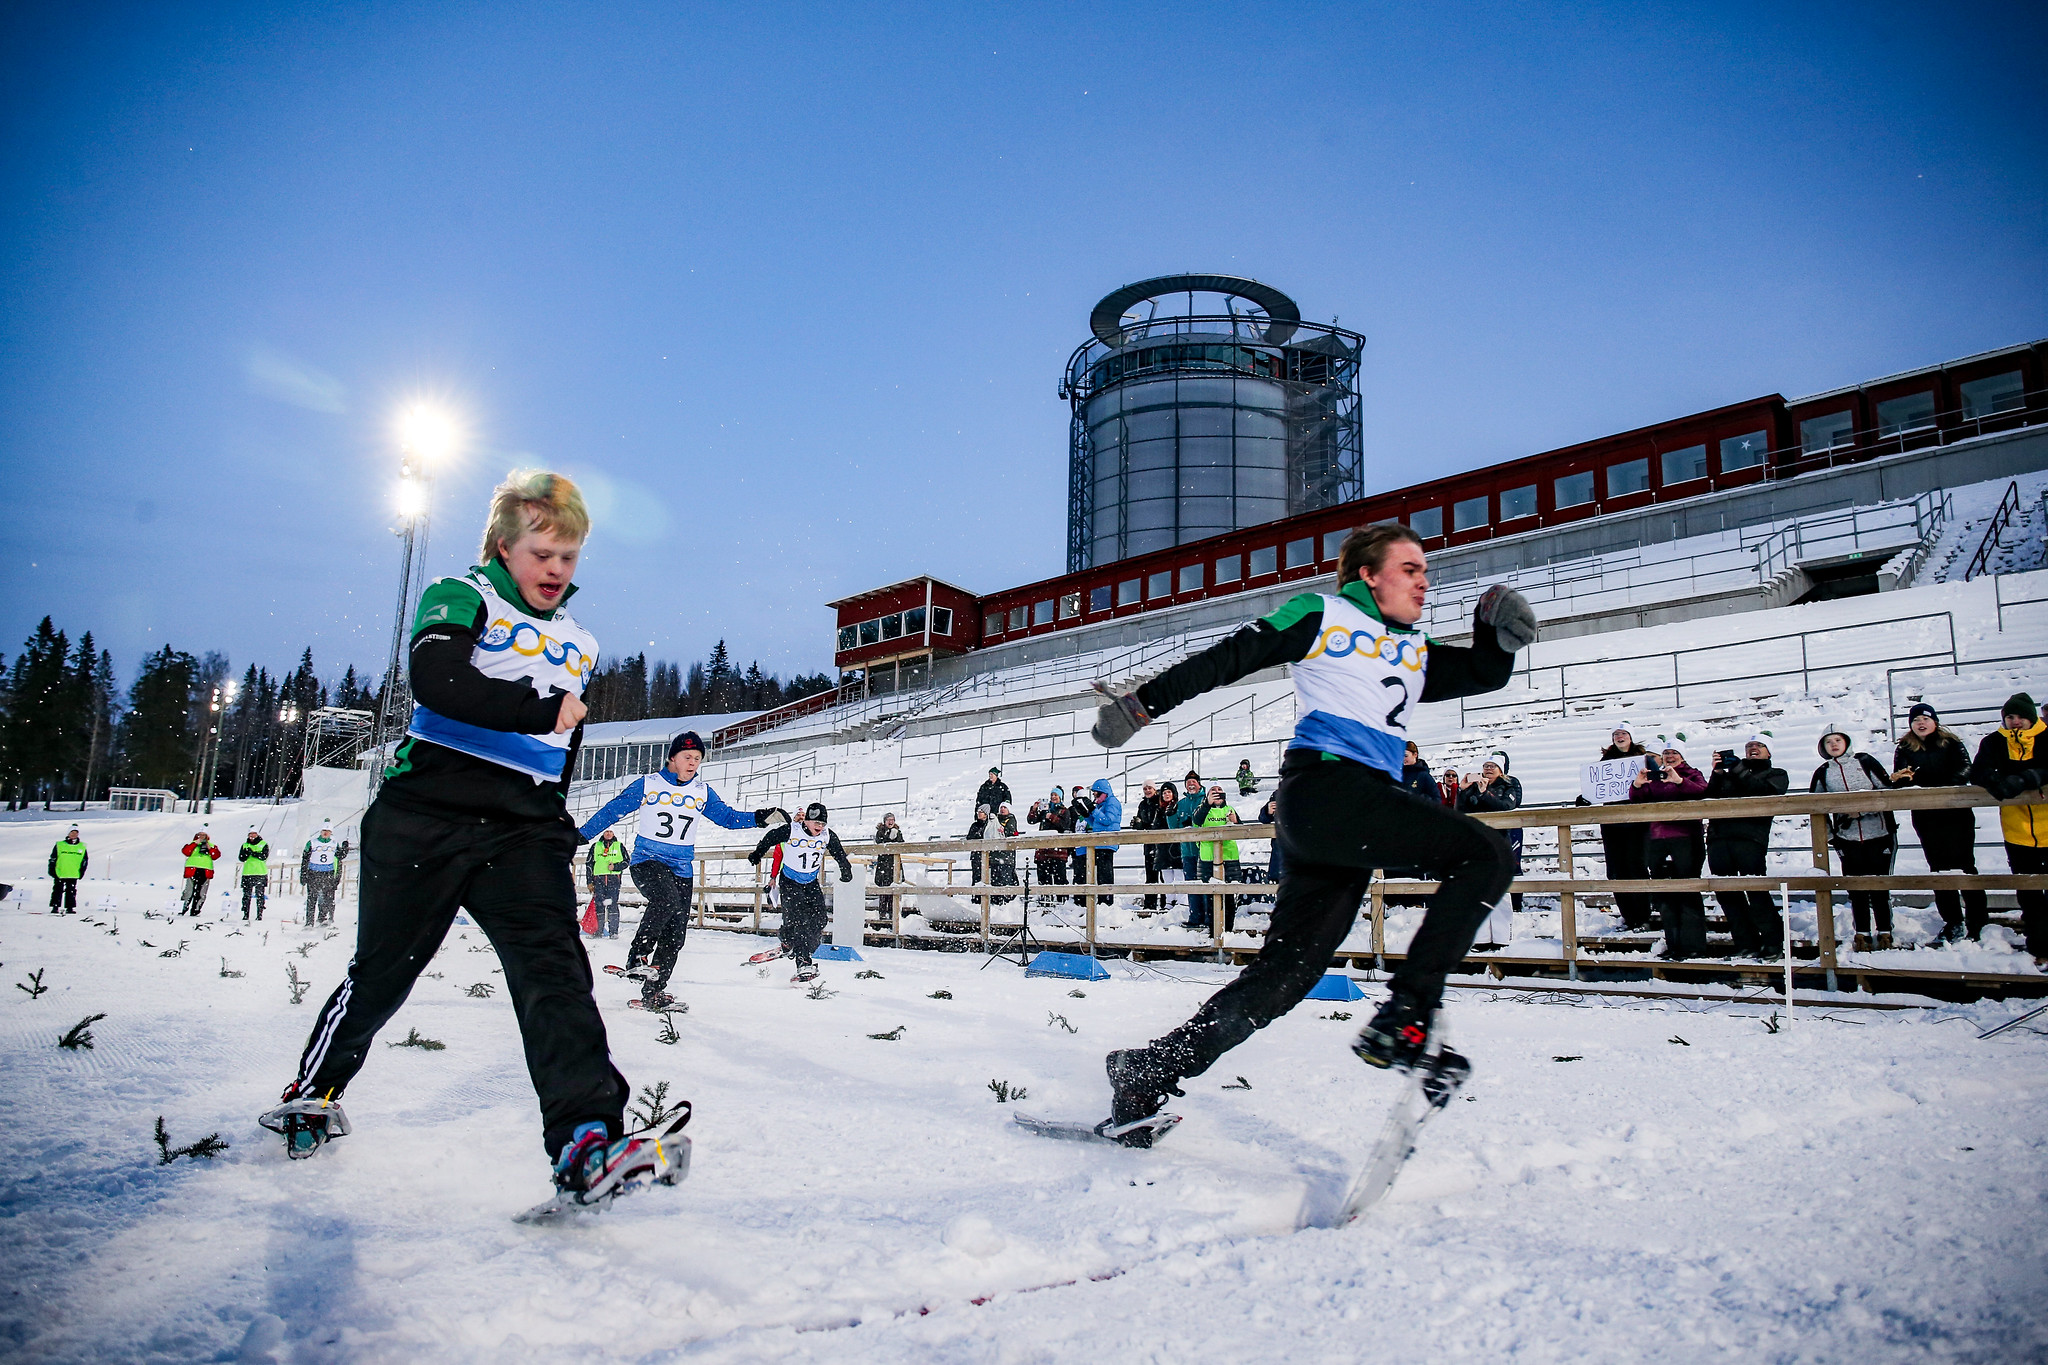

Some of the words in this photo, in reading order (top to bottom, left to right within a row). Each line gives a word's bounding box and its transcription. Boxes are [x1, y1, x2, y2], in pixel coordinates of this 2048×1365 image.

[1380, 676, 1408, 731] 2
[1590, 761, 1639, 783] HEJA
[655, 811, 695, 841] 37
[320, 853, 328, 863] 8
[798, 852, 820, 869] 12
